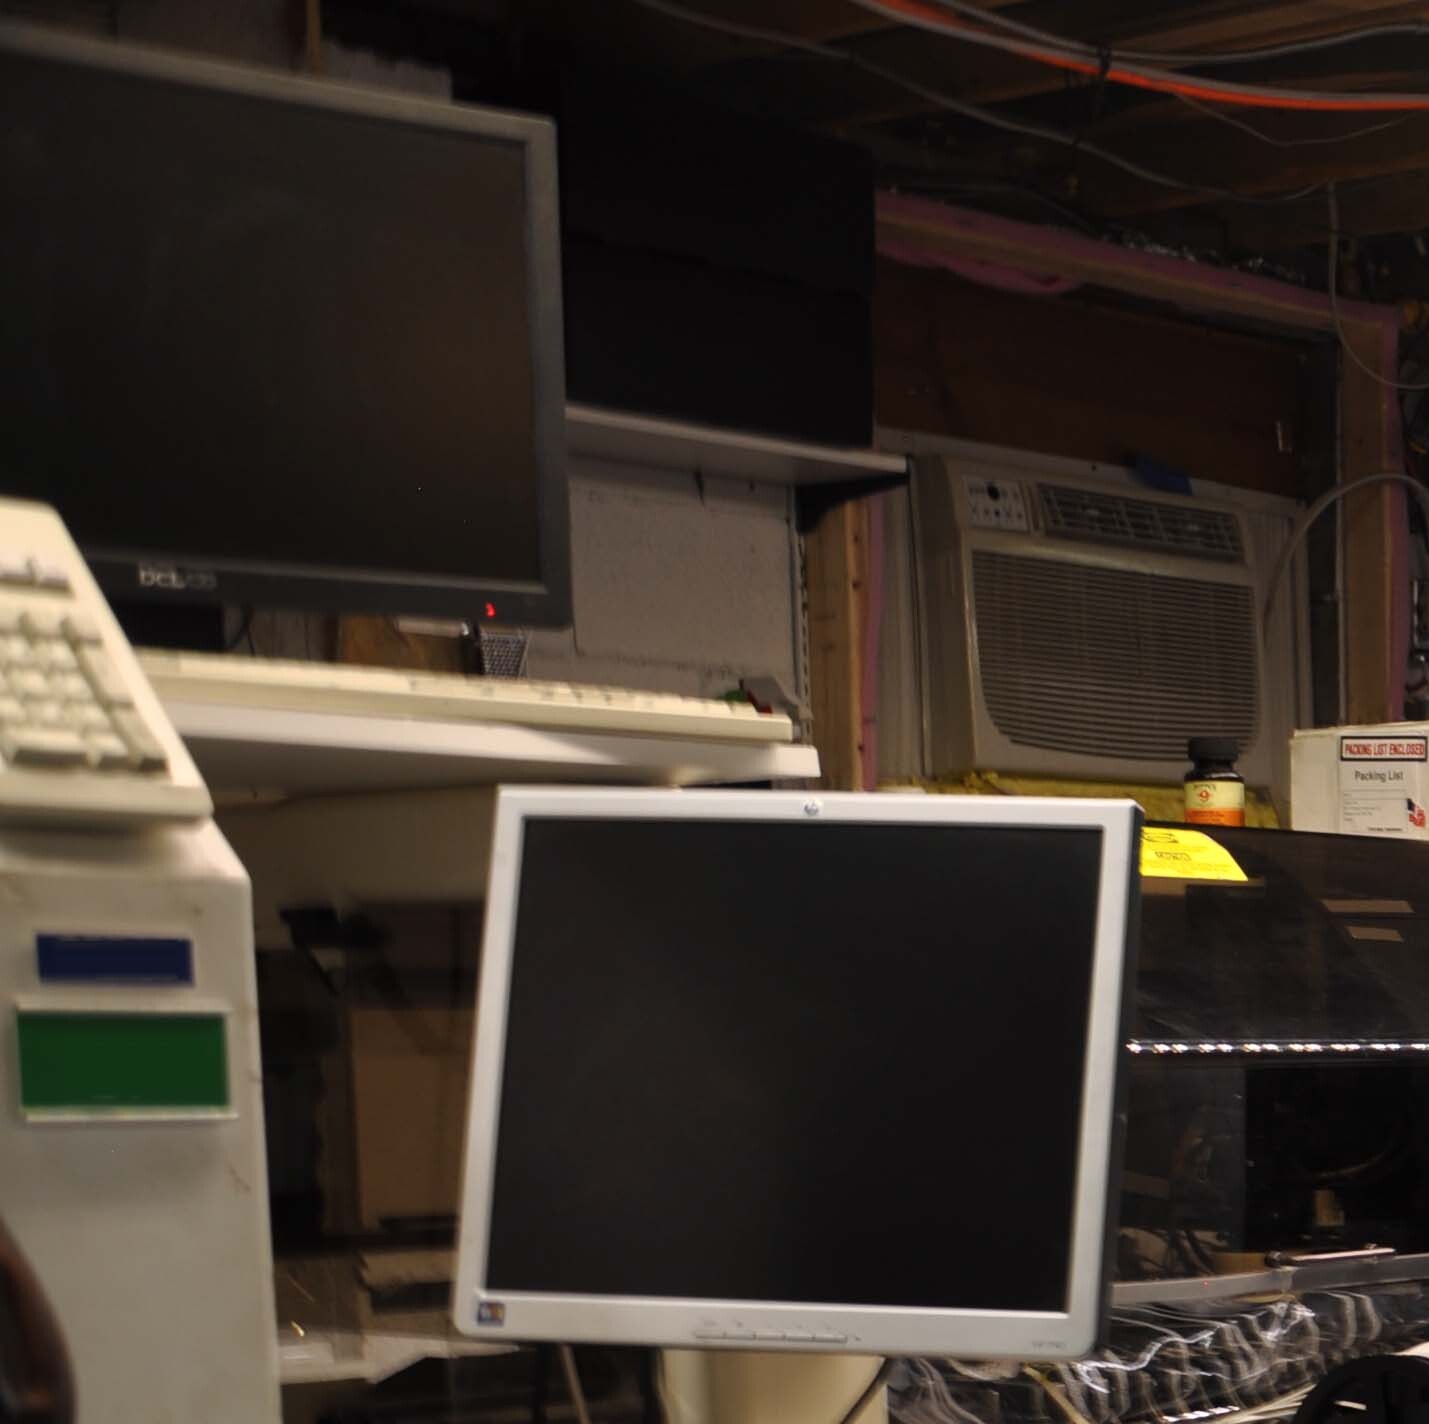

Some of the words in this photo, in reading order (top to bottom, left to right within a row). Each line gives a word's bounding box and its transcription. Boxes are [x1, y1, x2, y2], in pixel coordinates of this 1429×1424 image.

[1345, 744, 1372, 756] PACKING
[1374, 744, 1387, 756] LIST
[1389, 744, 1425, 756] ENCLOSED
[1354, 771, 1386, 783] Packing
[1388, 771, 1404, 781] List
